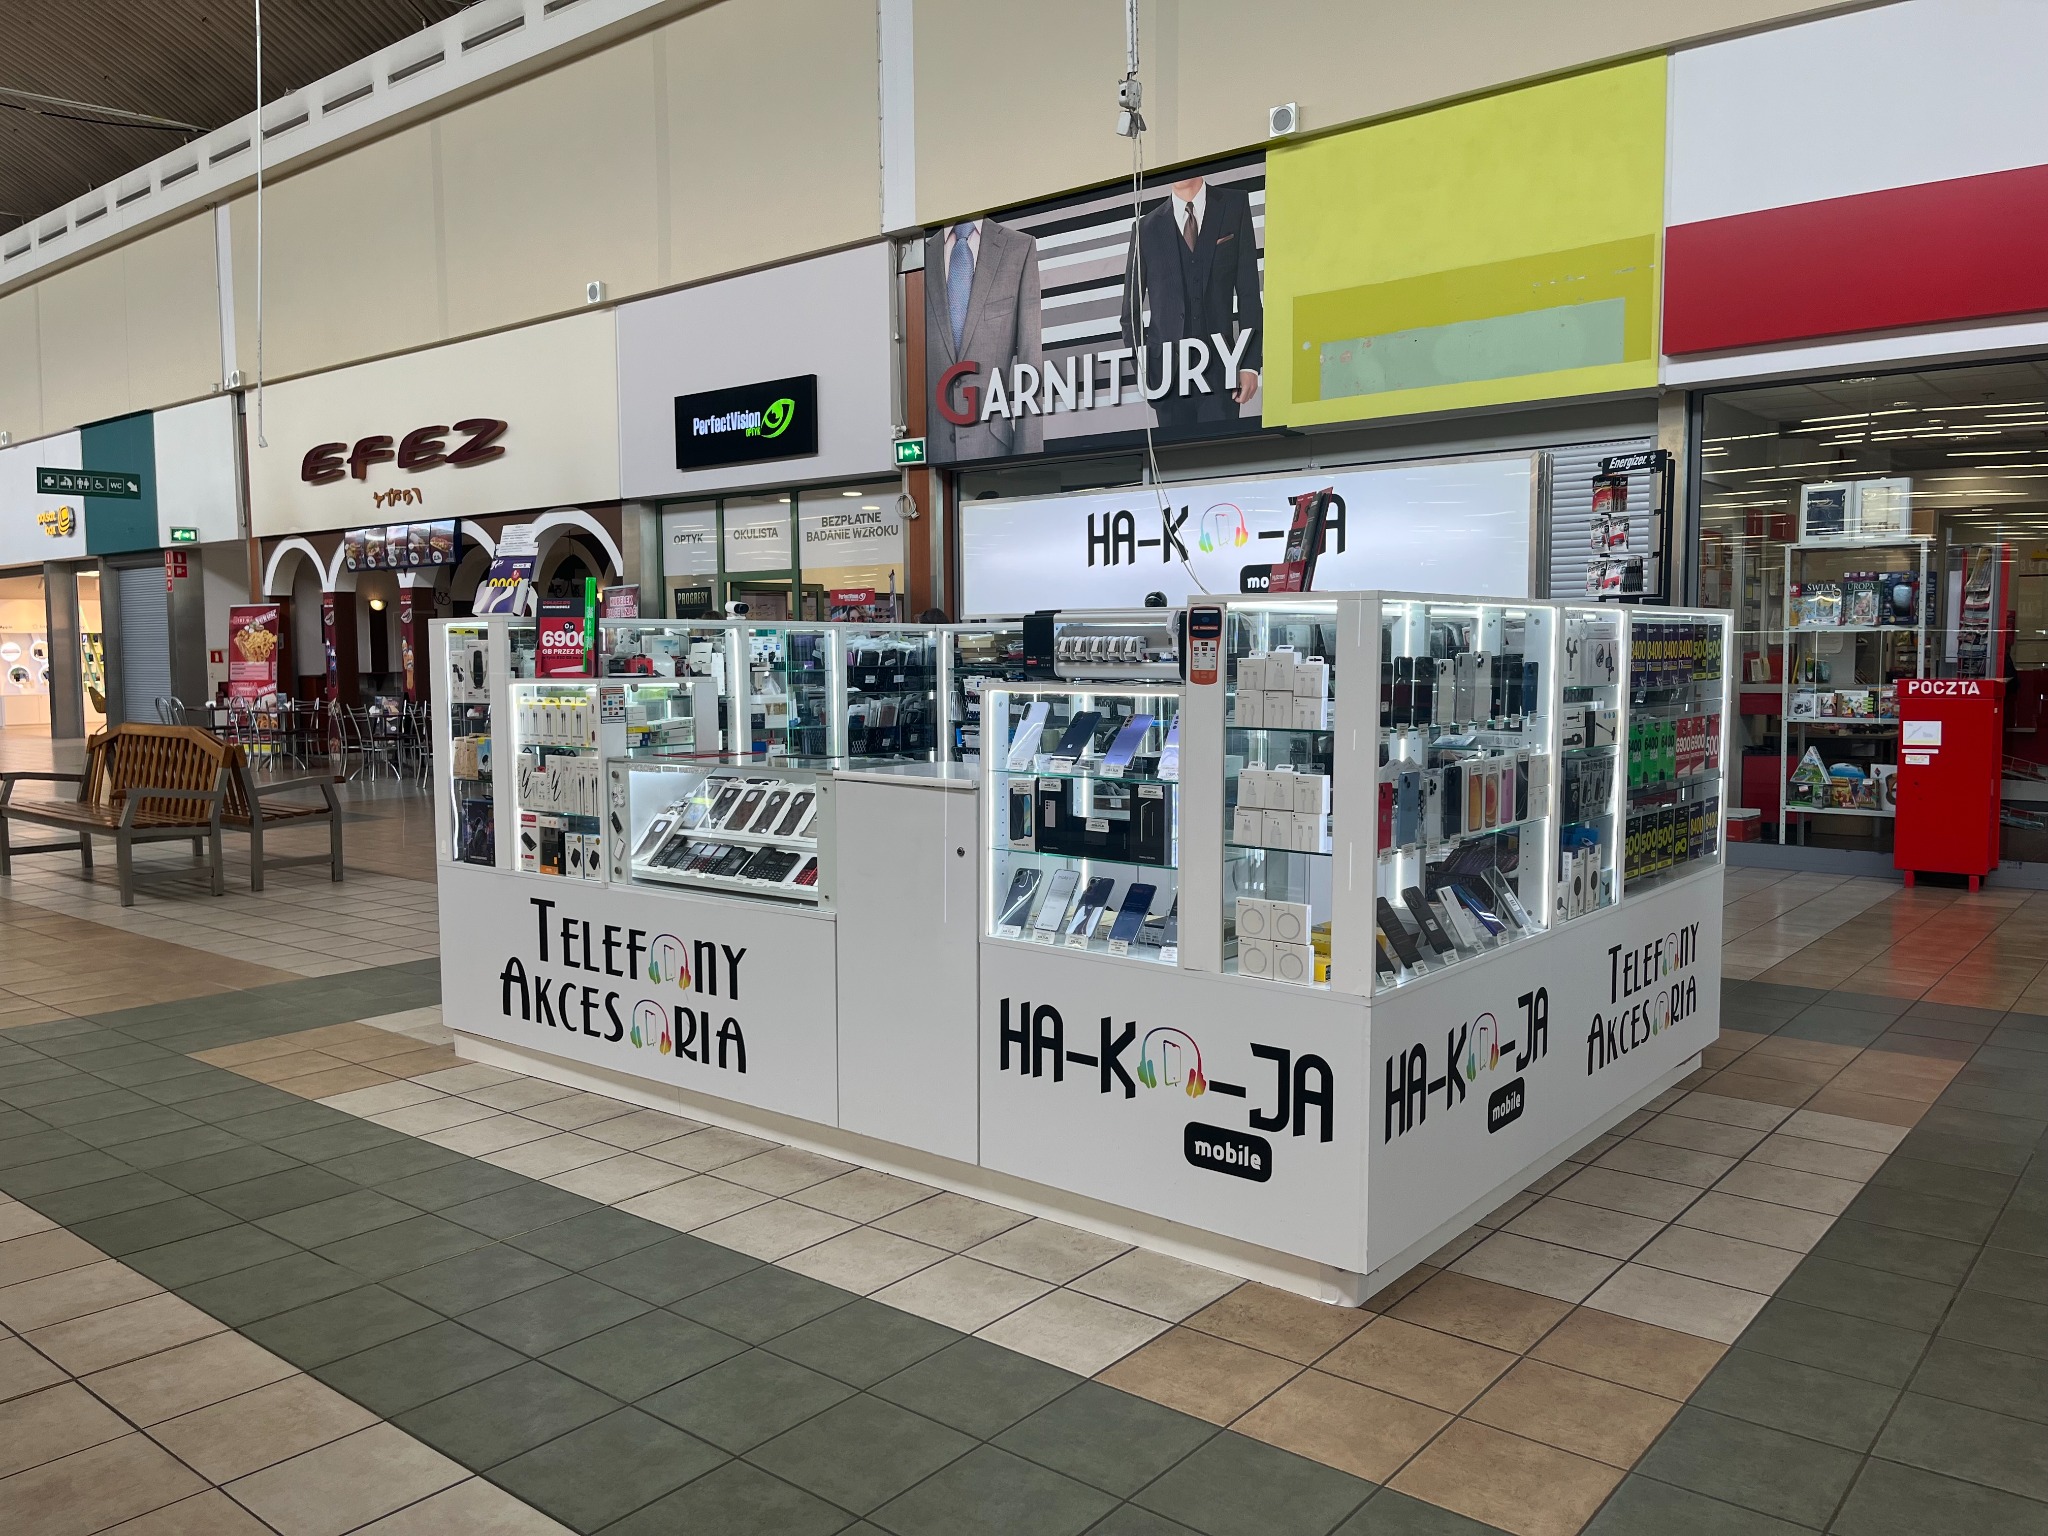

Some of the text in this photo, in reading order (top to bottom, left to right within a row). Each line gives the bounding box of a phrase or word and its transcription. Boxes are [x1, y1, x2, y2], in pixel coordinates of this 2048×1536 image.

[936, 327, 1254, 426] GARNITURY
[692, 410, 761, 436] PerfectVision
[301, 418, 508, 482] EFEZ
[110, 482, 122, 490] WC
[821, 512, 882, 528] BEZPŁATNE
[673, 533, 704, 545] OPTYK
[733, 527, 779, 541] OKULISTA
[806, 525, 899, 542] BADANIE WZROKU
[1647, 641, 1663, 660] 8400
[1663, 640, 1678, 659] 8400
[1679, 639, 1692, 658] 8400
[1693, 639, 1707, 660] 500
[1908, 680, 1981, 695] POCZTA
[1641, 828, 1656, 853] 500
[1657, 825, 1673, 849] 500
[530, 897, 747, 1000] TELEFONY
[1608, 921, 1700, 1005] TELEFONY
[500, 957, 747, 1074] AKCESORIA
[1587, 975, 1697, 1077] AKCESORIA
[1492, 1091, 1522, 1123] mobile
[1194, 1139, 1262, 1170] mobile
